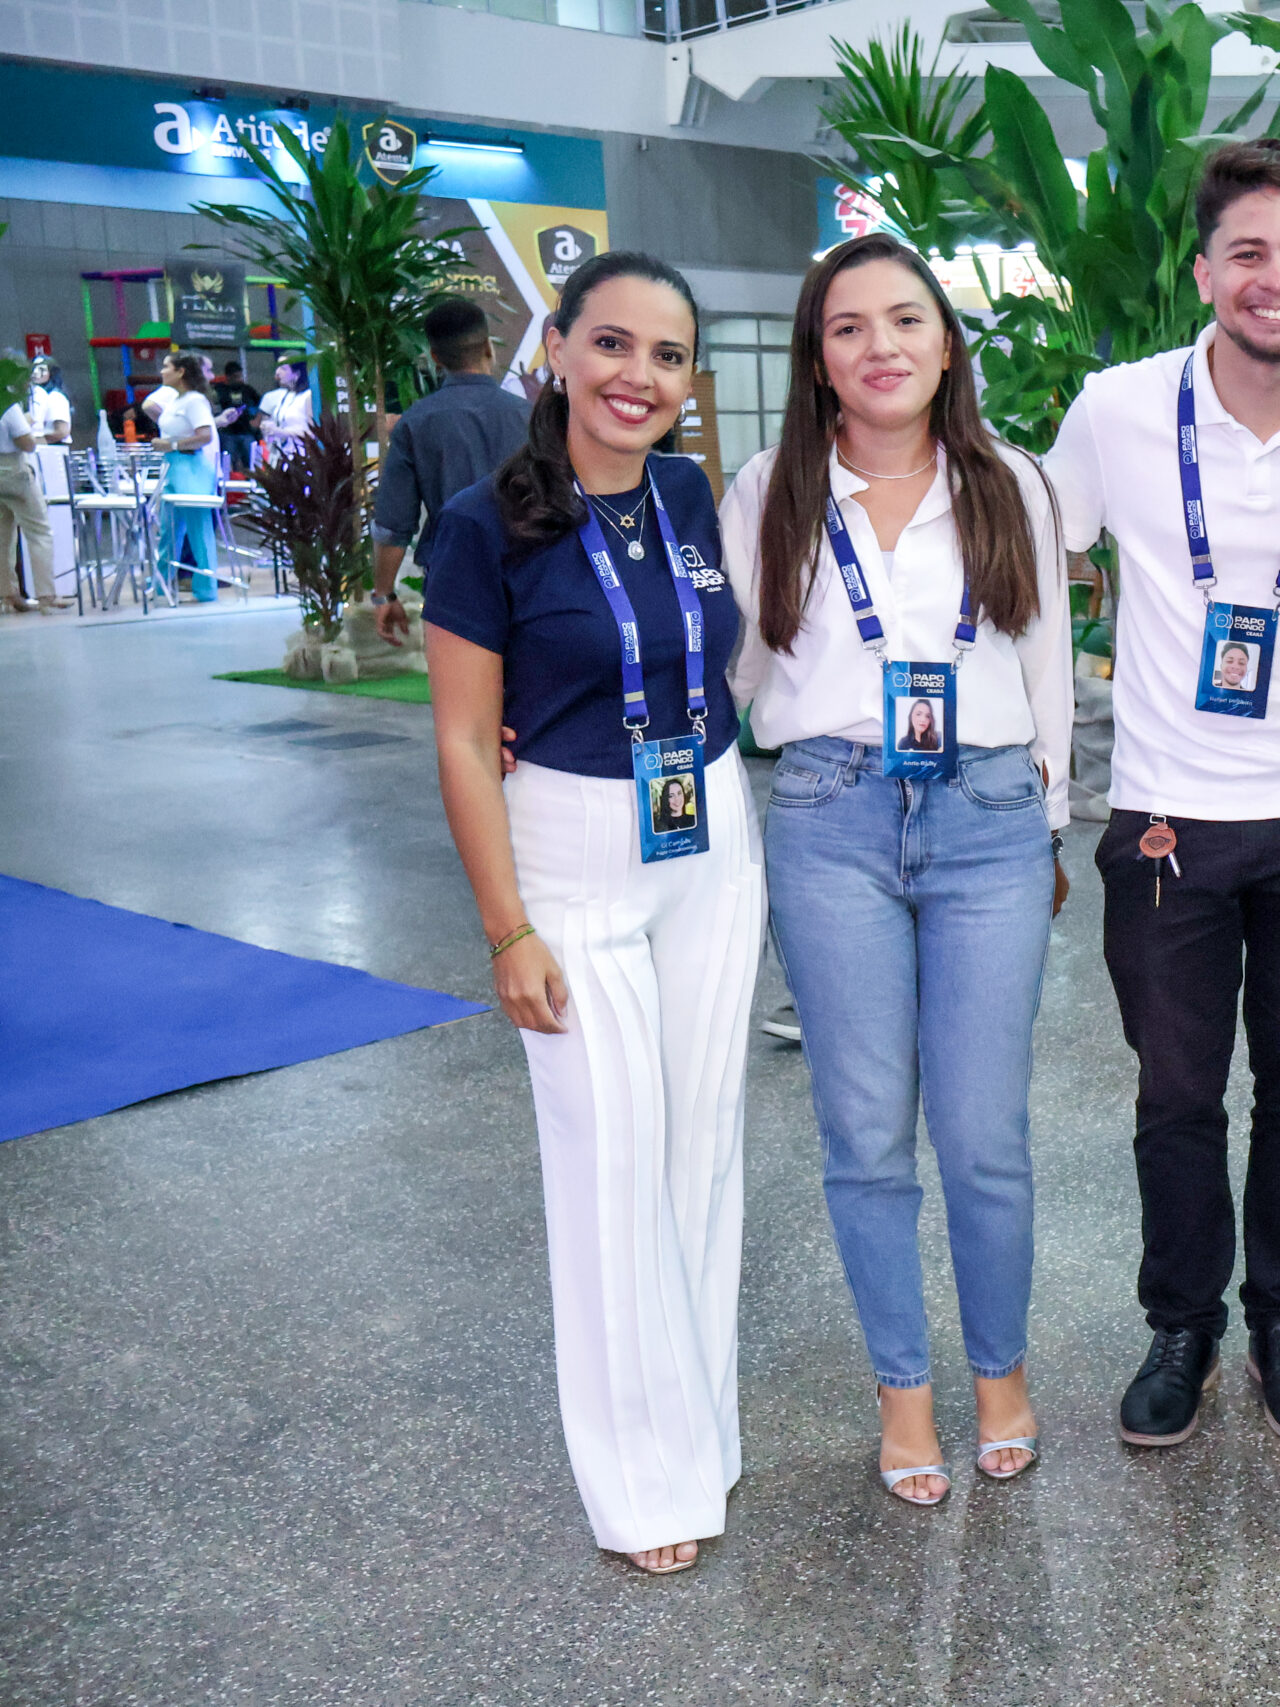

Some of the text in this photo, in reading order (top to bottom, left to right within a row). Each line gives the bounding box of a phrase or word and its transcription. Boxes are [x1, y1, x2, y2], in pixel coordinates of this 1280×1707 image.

[1187, 500, 1196, 526] PAPO
[592, 552, 605, 577] PAPO
[842, 565, 853, 590] PAPO
[1235, 616, 1266, 626] PAPO
[1234, 623, 1265, 632] CONDO
[622, 622, 631, 650] PAPO
[913, 674, 945, 682] PAPO
[663, 749, 694, 760] PAPO
[664, 756, 694, 766] CONDO
